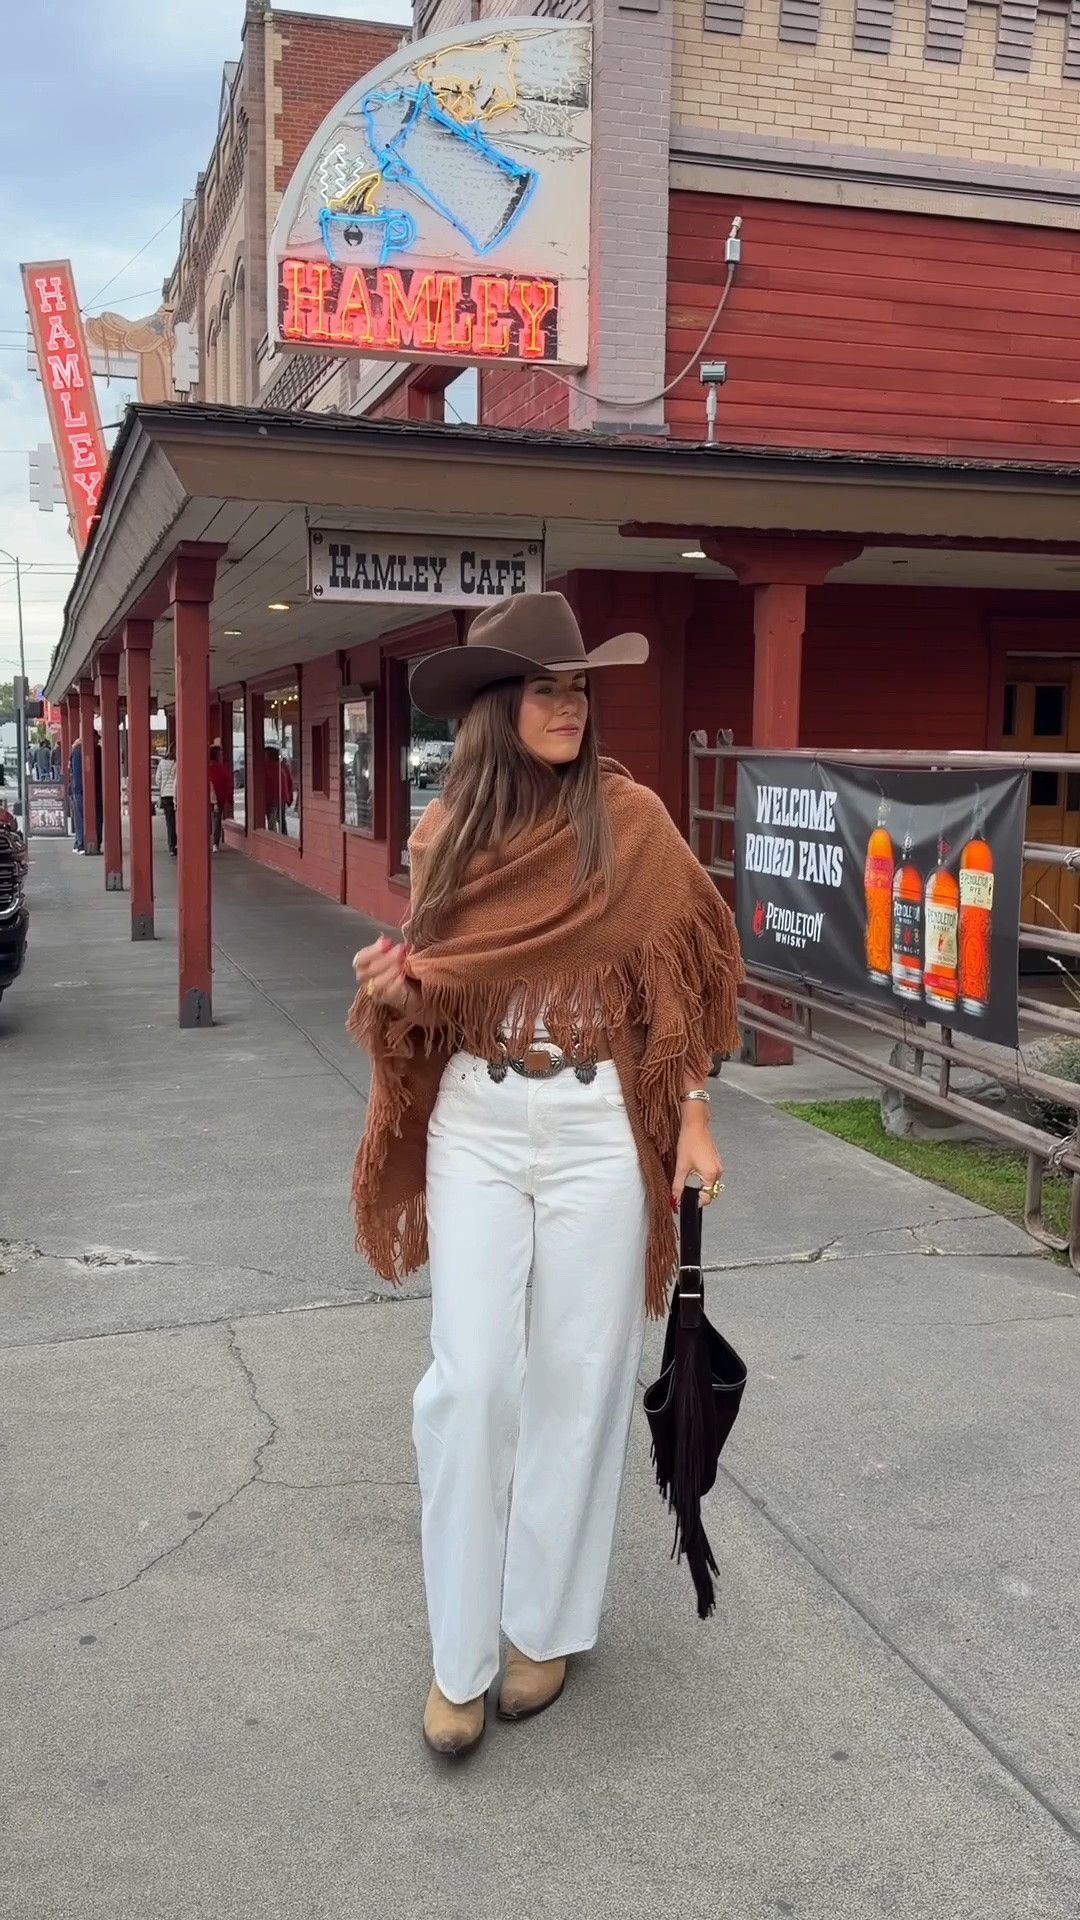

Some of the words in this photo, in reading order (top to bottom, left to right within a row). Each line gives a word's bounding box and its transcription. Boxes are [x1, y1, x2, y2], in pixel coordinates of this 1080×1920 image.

[282, 258, 554, 358] HAMLEY
[35, 276, 101, 506] HAMLEY
[756, 785, 838, 832] WELCOME
[745, 833, 795, 878] RODEO
[798, 841, 843, 887] FANS
[765, 902, 823, 942] PENDLETON
[775, 931, 807, 948] WHISKY
